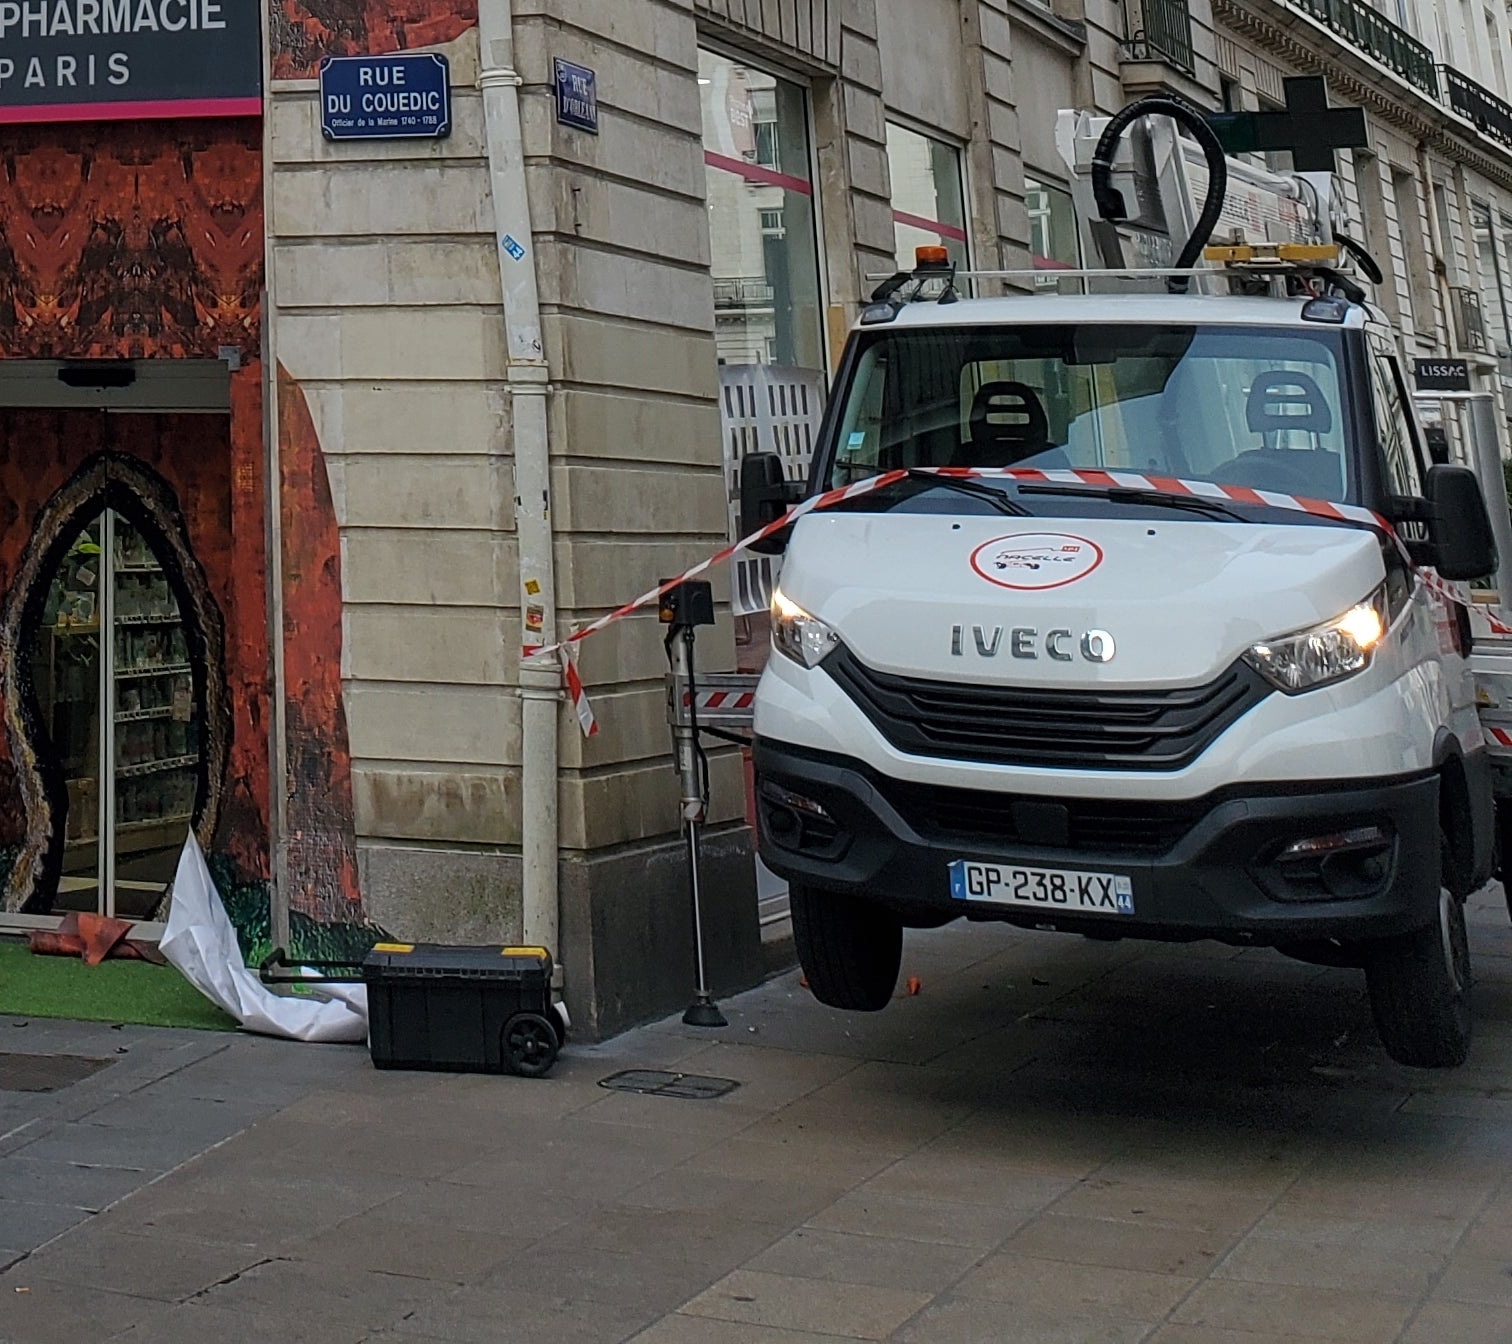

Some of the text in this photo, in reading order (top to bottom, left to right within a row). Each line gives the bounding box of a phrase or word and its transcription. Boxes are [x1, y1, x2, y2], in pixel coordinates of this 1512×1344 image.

[359, 66, 406, 86] RUE
[328, 91, 440, 113] DU COUEDIC
[357, 118, 366, 127] de
[368, 118, 375, 127] la
[377, 116, 399, 127] Marine
[1421, 365, 1466, 377] LISSAC
[951, 624, 1117, 663] IVECO
[967, 866, 1116, 909] GP-238-KX
[1117, 894, 1132, 910] 44
